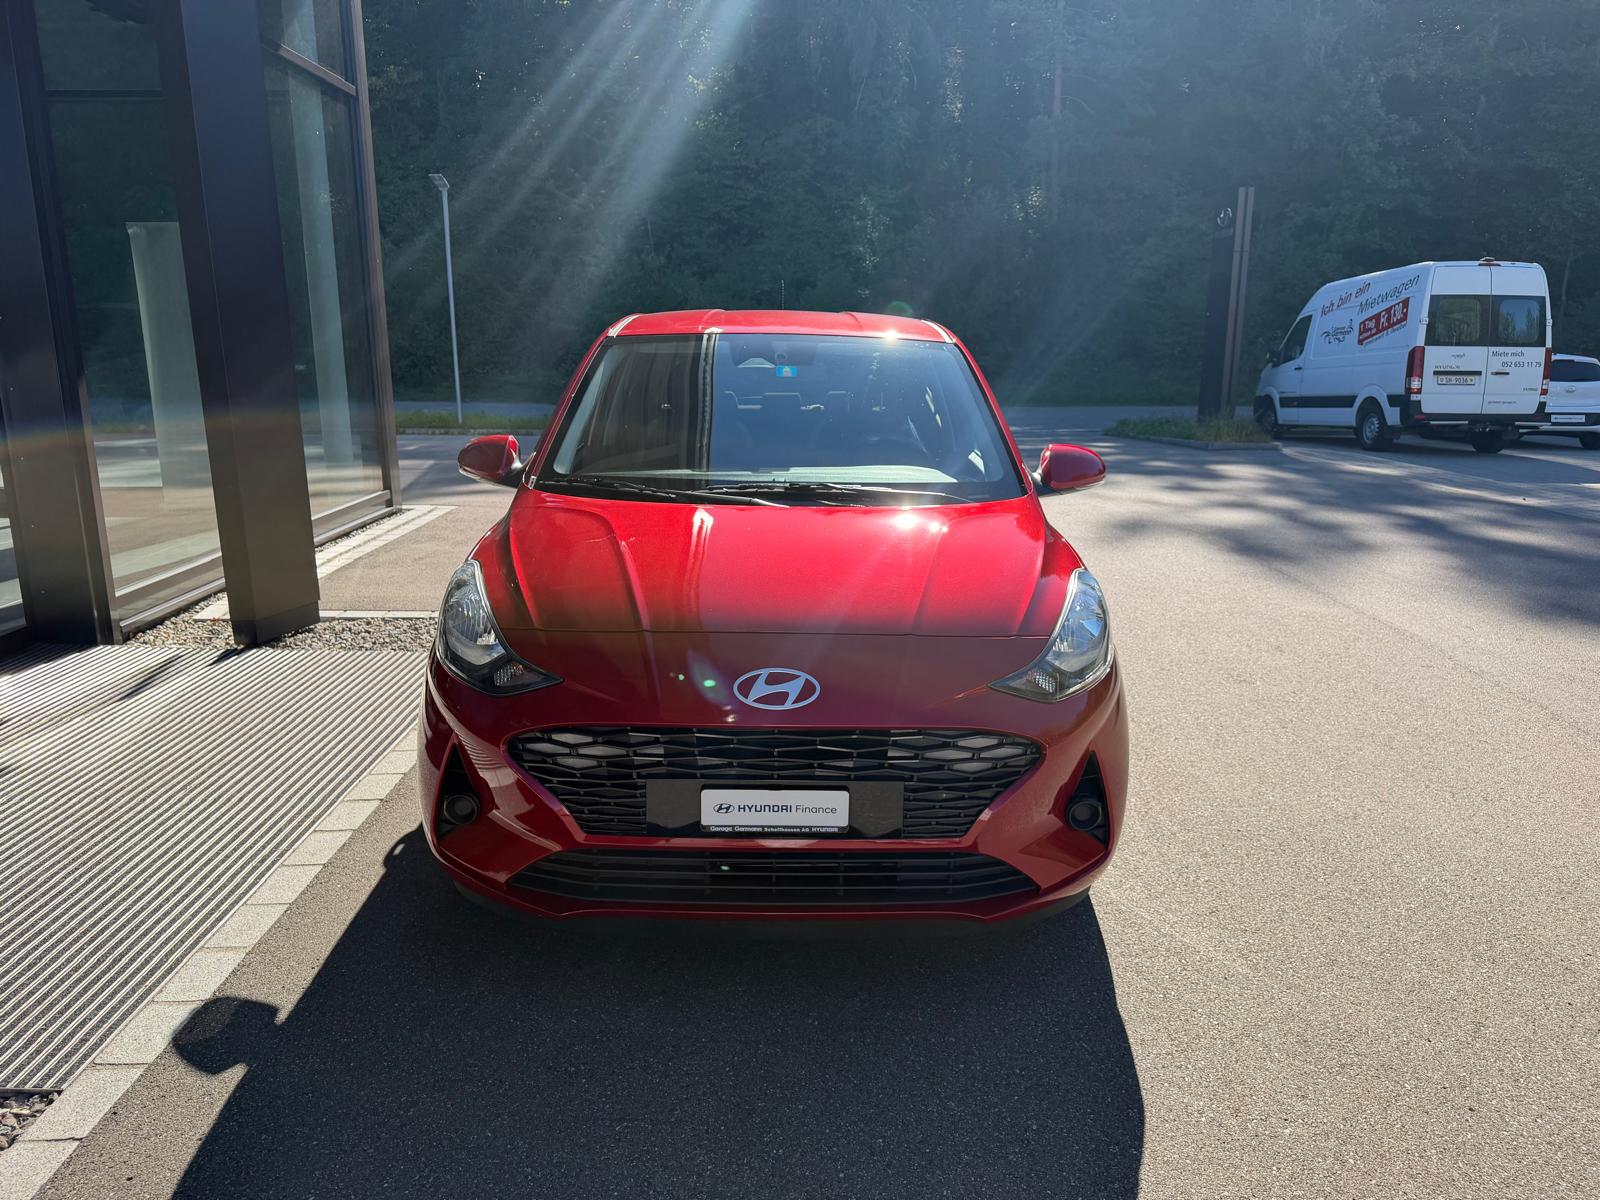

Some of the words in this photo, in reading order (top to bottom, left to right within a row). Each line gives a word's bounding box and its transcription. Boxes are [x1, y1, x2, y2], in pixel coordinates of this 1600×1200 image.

[1320, 300, 1335, 317] Ich
[1336, 291, 1352, 308] bin
[1354, 281, 1371, 298] ein
[1357, 275, 1420, 316] Mietwagen
[1491, 350, 1509, 358] Miete
[1510, 350, 1525, 358] mich
[738, 804, 792, 813] HYUNDAI
[795, 804, 838, 814] Finance
